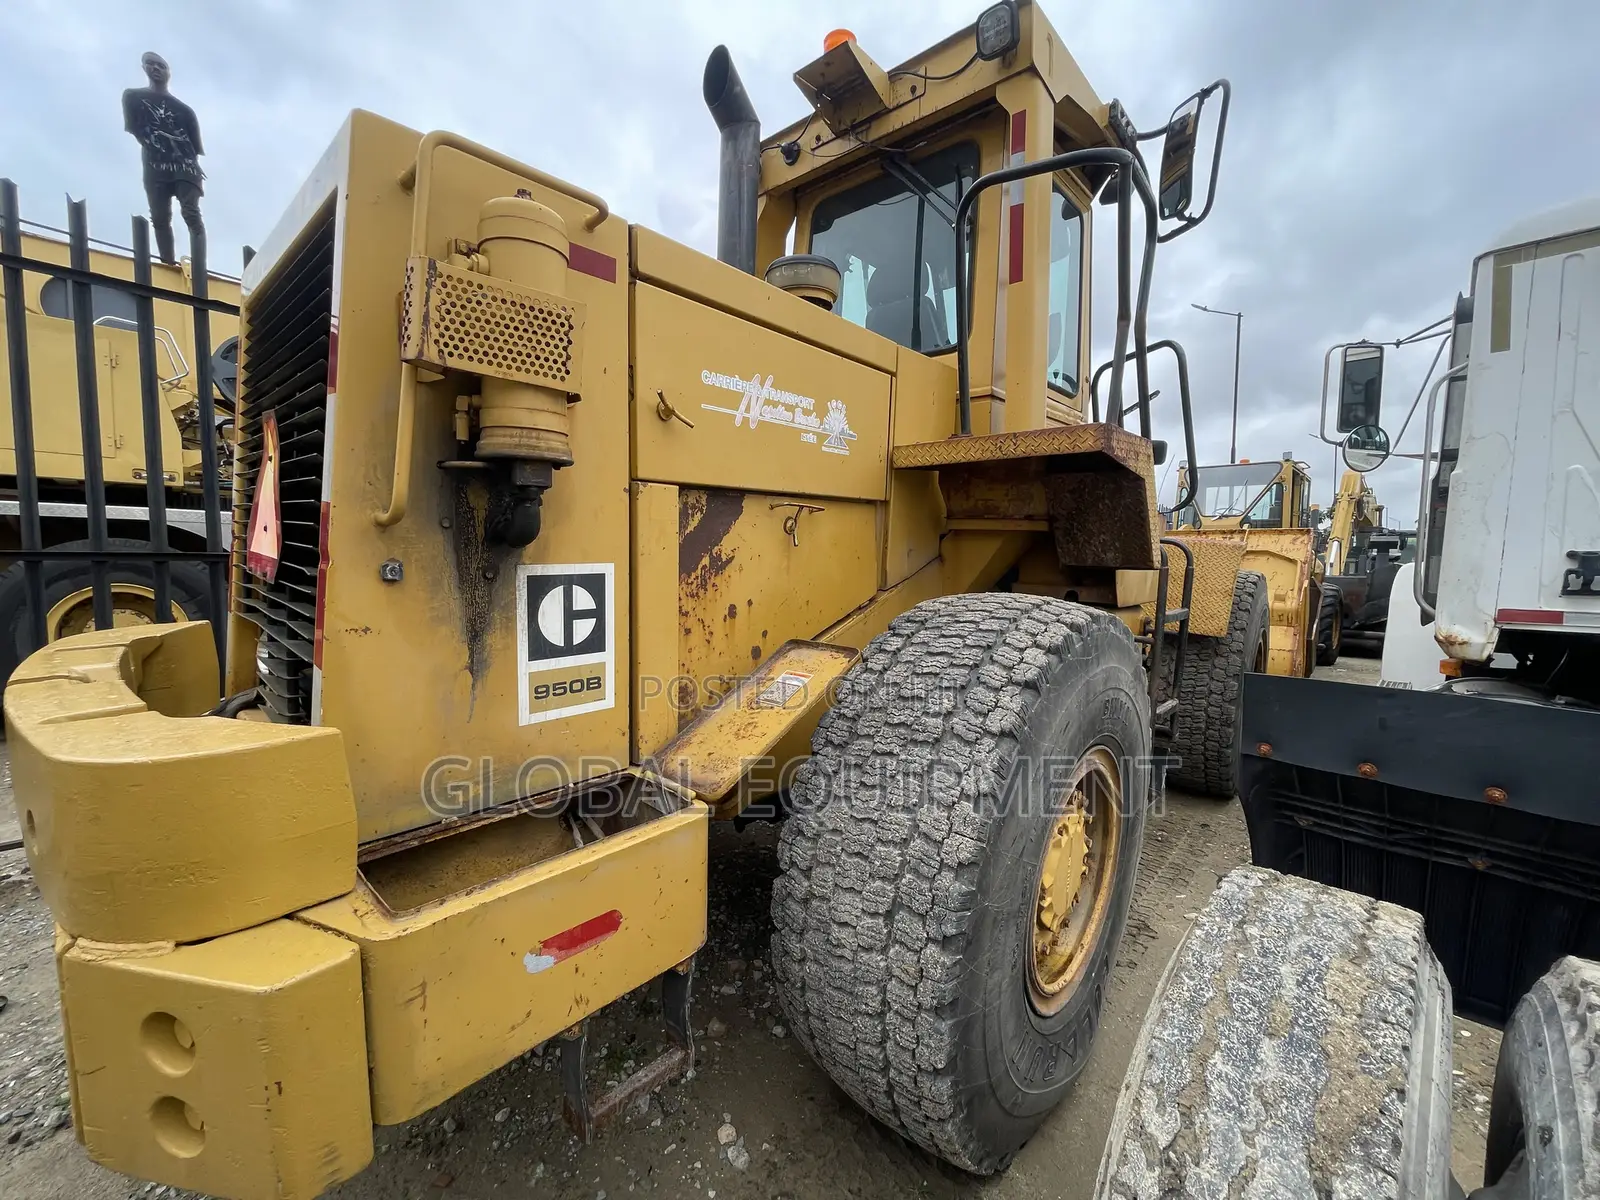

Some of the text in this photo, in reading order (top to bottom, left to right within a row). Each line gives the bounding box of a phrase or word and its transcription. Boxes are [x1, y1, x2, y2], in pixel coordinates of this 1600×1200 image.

[701, 370, 754, 393] CARRIÈRE
[765, 387, 815, 410] TRANSPORT
[534, 676, 602, 700] 950B
